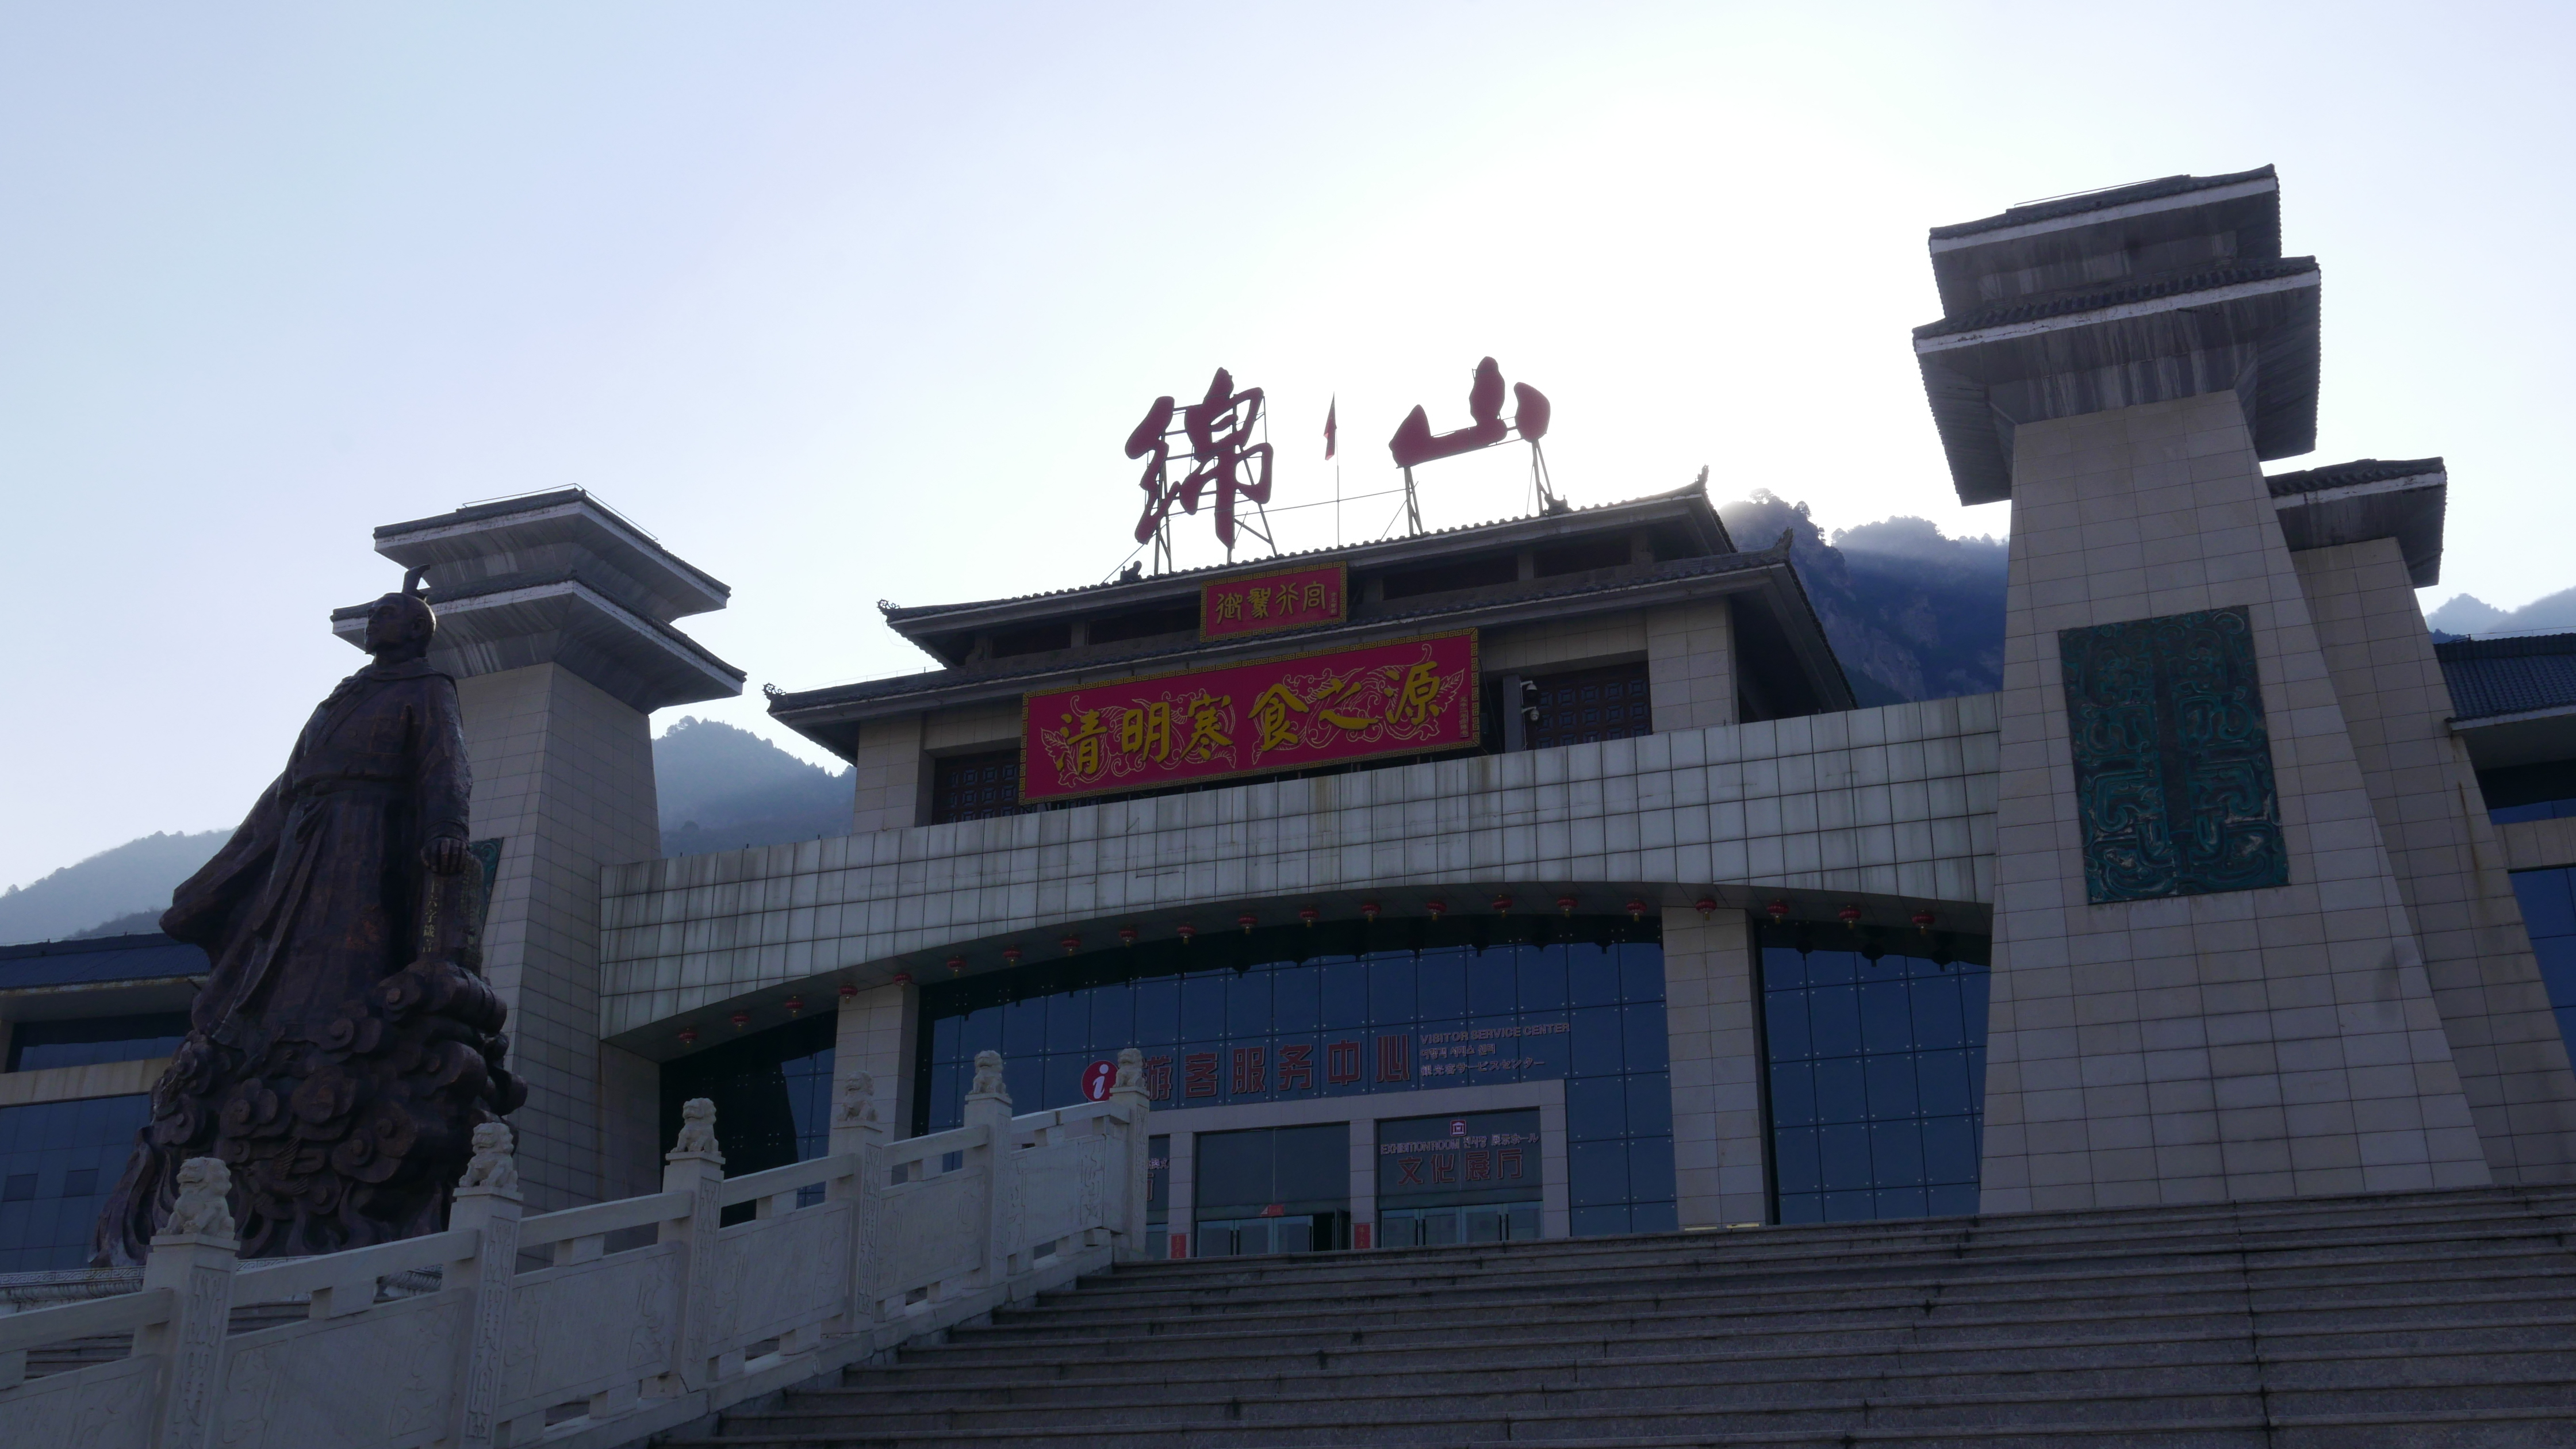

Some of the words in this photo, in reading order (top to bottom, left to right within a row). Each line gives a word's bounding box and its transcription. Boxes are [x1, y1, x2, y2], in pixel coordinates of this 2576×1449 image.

[1055, 661, 1444, 775] 清明寒食之源
[423, 880, 439, 953] 十六字箴言
[1420, 1031, 1469, 1044] VISITOR
[1470, 1026, 1521, 1041] SERVICE
[1523, 1022, 1570, 1036] CENTER
[1141, 1034, 1410, 1101] 游客服务中心
[1398, 1148, 1523, 1186] 文化展厅
